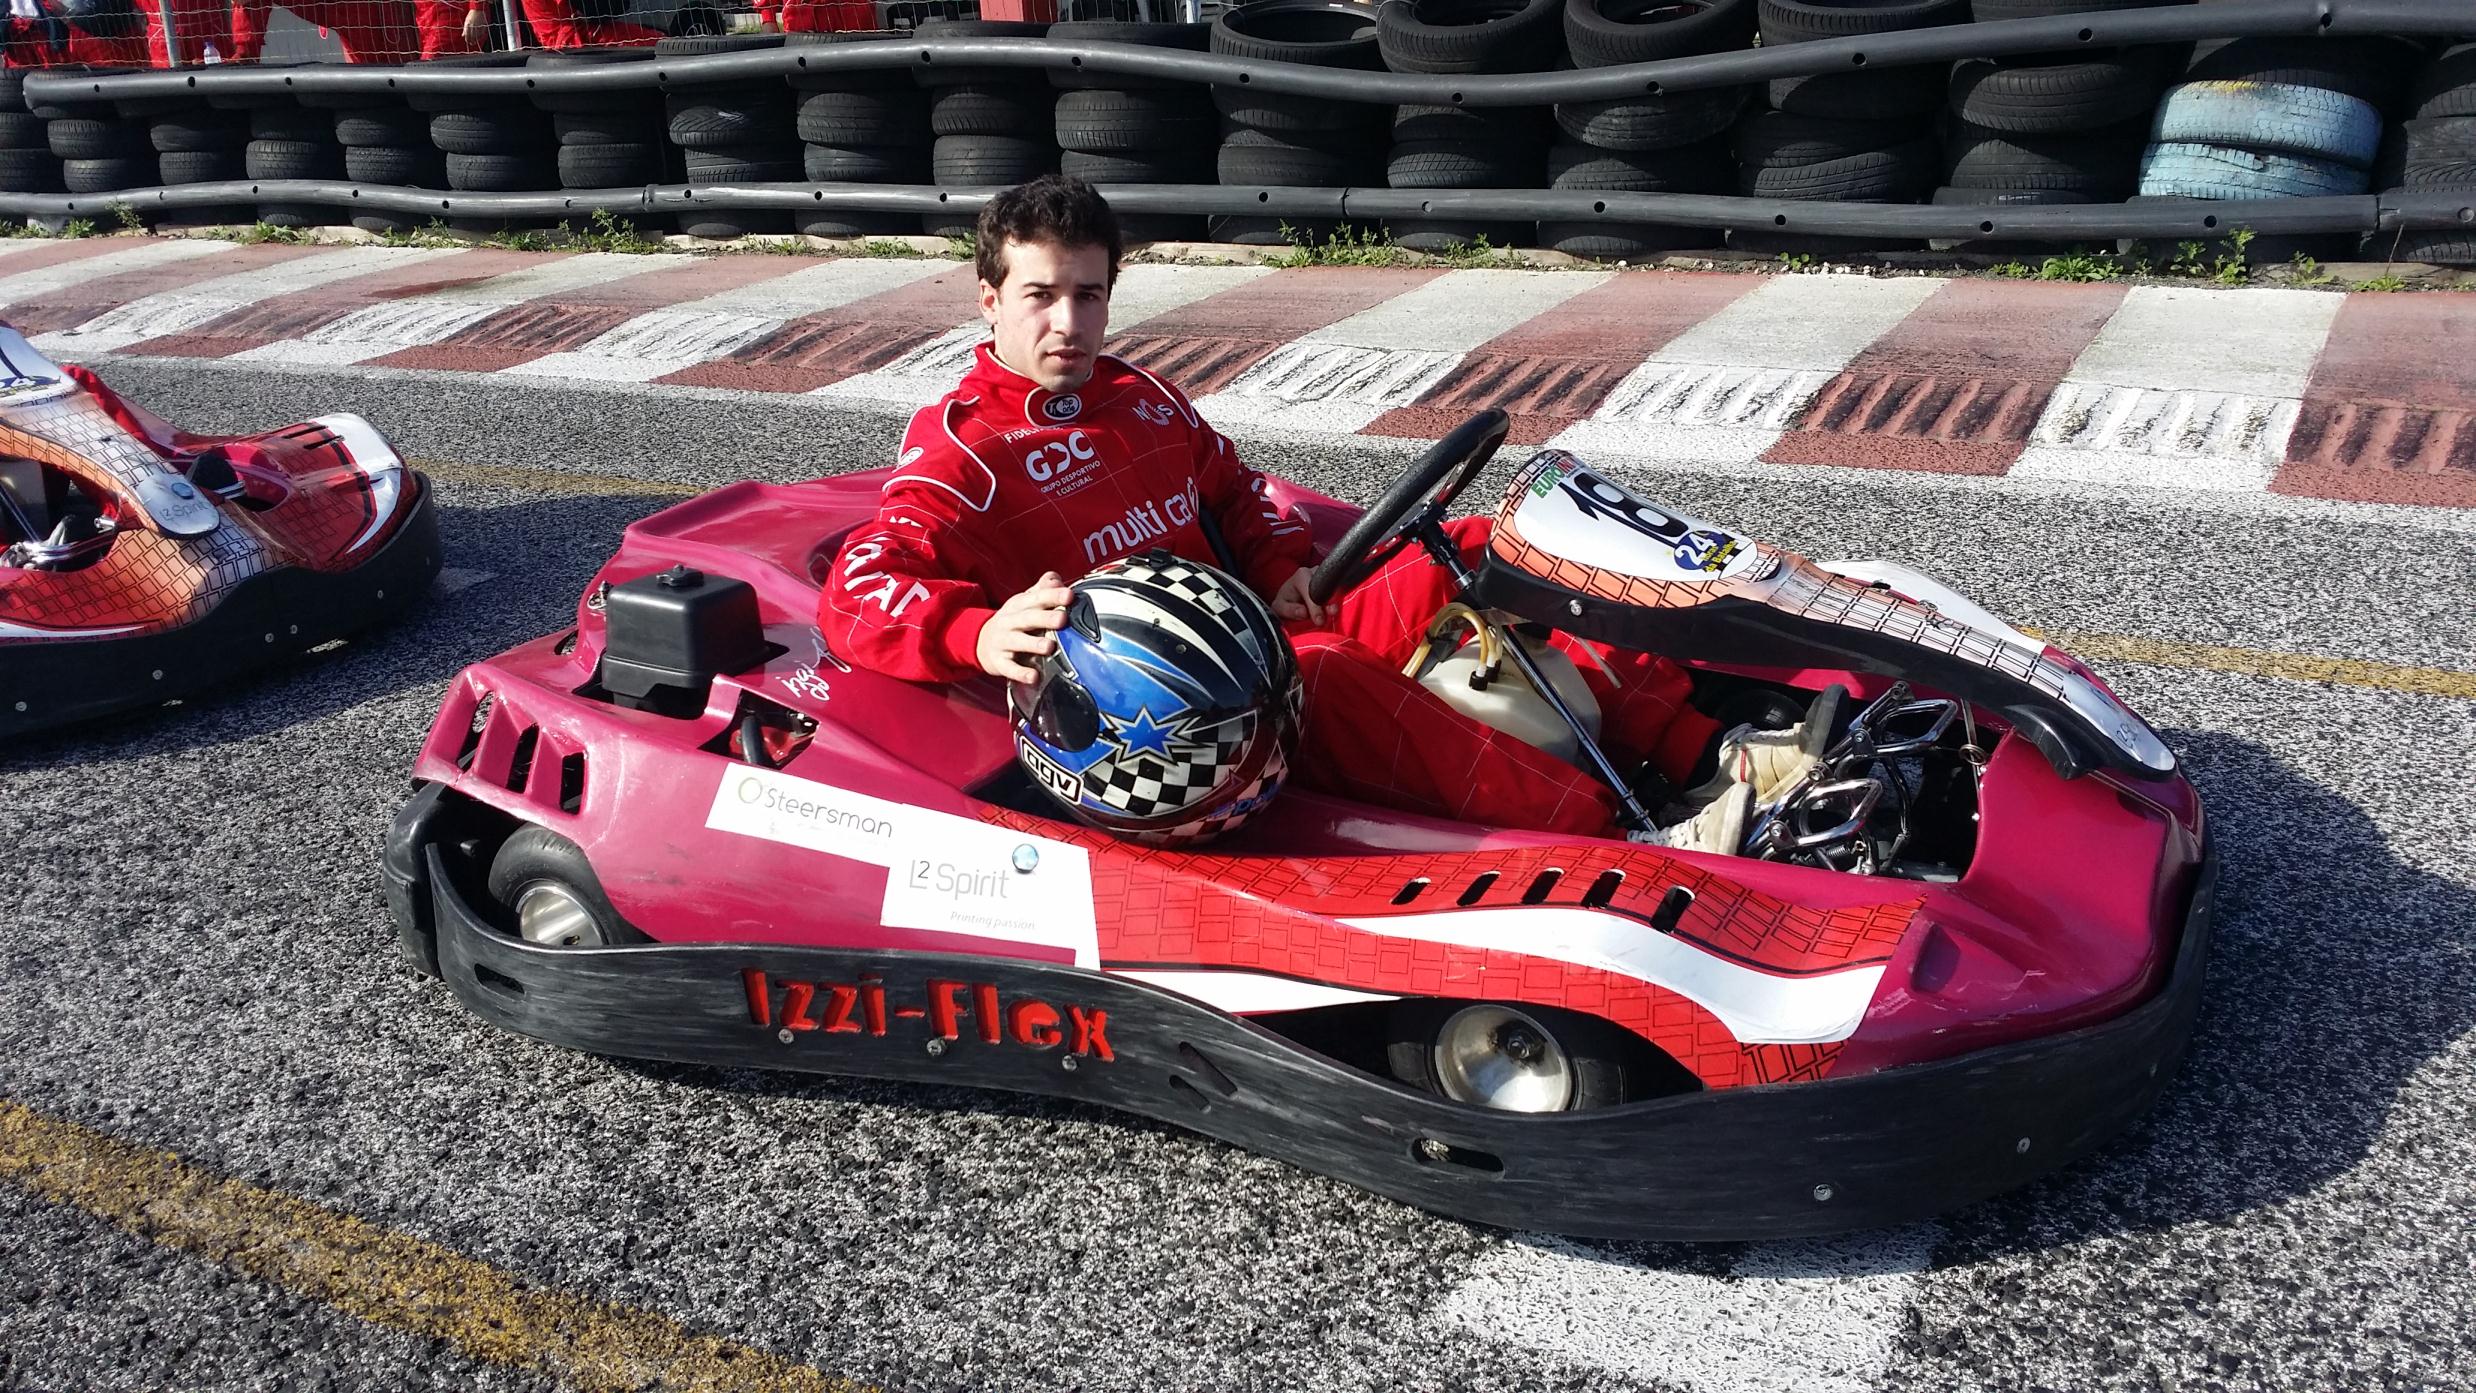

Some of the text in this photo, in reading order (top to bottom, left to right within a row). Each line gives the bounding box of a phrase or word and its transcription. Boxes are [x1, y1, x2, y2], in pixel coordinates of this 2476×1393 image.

[1131, 398, 1175, 426] NOS
[1026, 430, 1095, 482] GDC
[1041, 460, 1101, 494] GRUPO DESPORTIVO
[1061, 476, 1094, 495] CULTURAL
[1557, 472, 1690, 549] 18
[1083, 500, 1168, 564] multi
[1675, 533, 1717, 566] 24
[1026, 749, 1073, 792] agv
[764, 787, 893, 838] Steersman
[935, 863, 1011, 901] Spirit
[950, 910, 1037, 931] Printing passion
